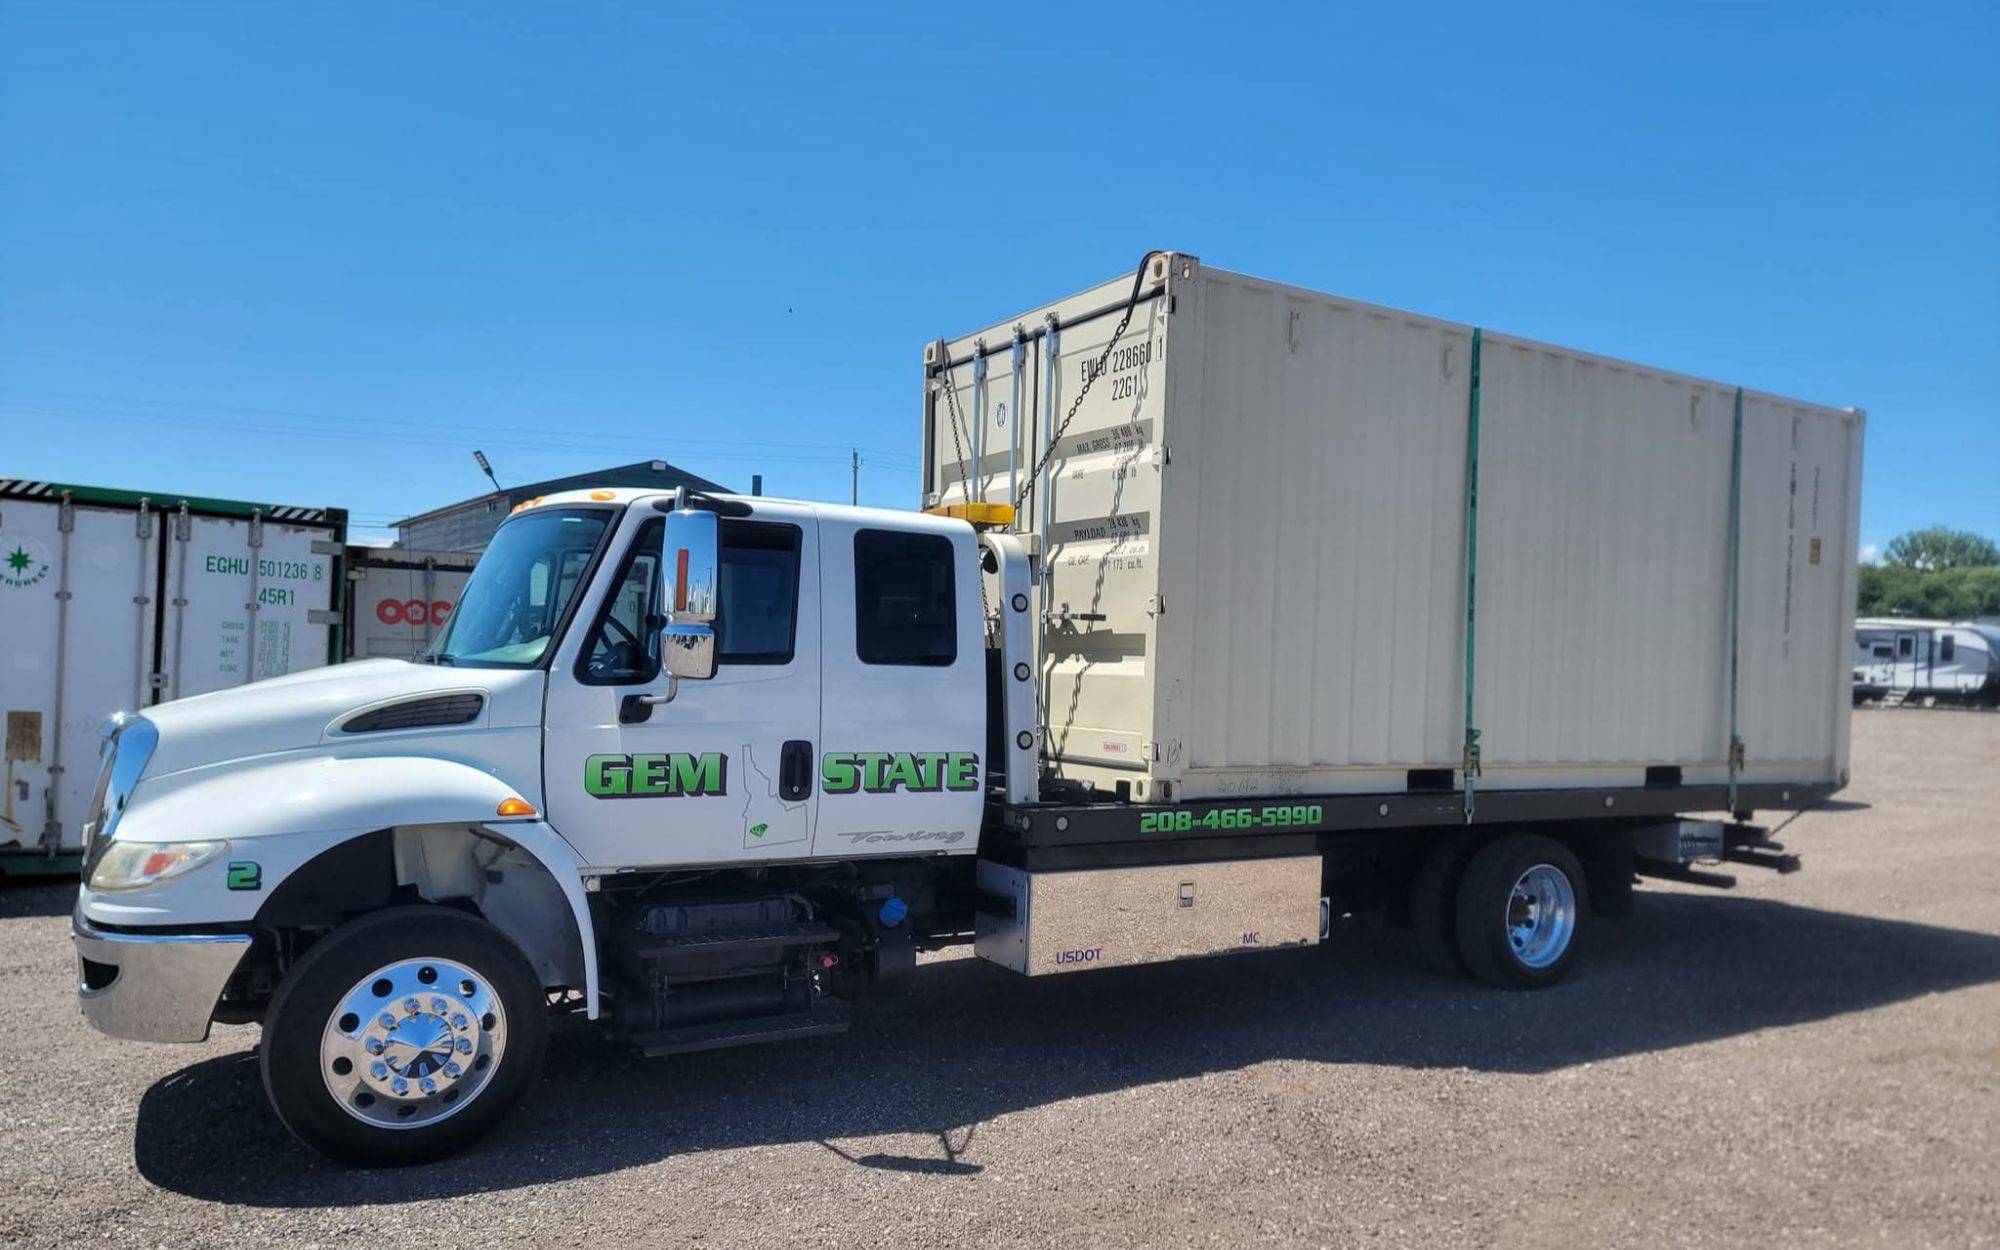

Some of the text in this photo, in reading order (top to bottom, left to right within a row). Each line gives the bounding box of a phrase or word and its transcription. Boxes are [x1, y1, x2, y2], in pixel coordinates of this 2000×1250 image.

[1112, 341, 1152, 373] 228660
[1112, 374, 1138, 401] 22G1
[1074, 527, 1106, 541] PAYLOAD
[206, 555, 322, 581] EGHU 501236 8
[258, 588, 295, 606] 45R1
[584, 751, 980, 799] GEM STATE
[1140, 804, 1323, 833] 208-466-5990
[837, 830, 967, 844] Towing
[228, 860, 262, 891] 2
[1242, 932, 1260, 945] MC
[1056, 948, 1103, 965] USDOT
